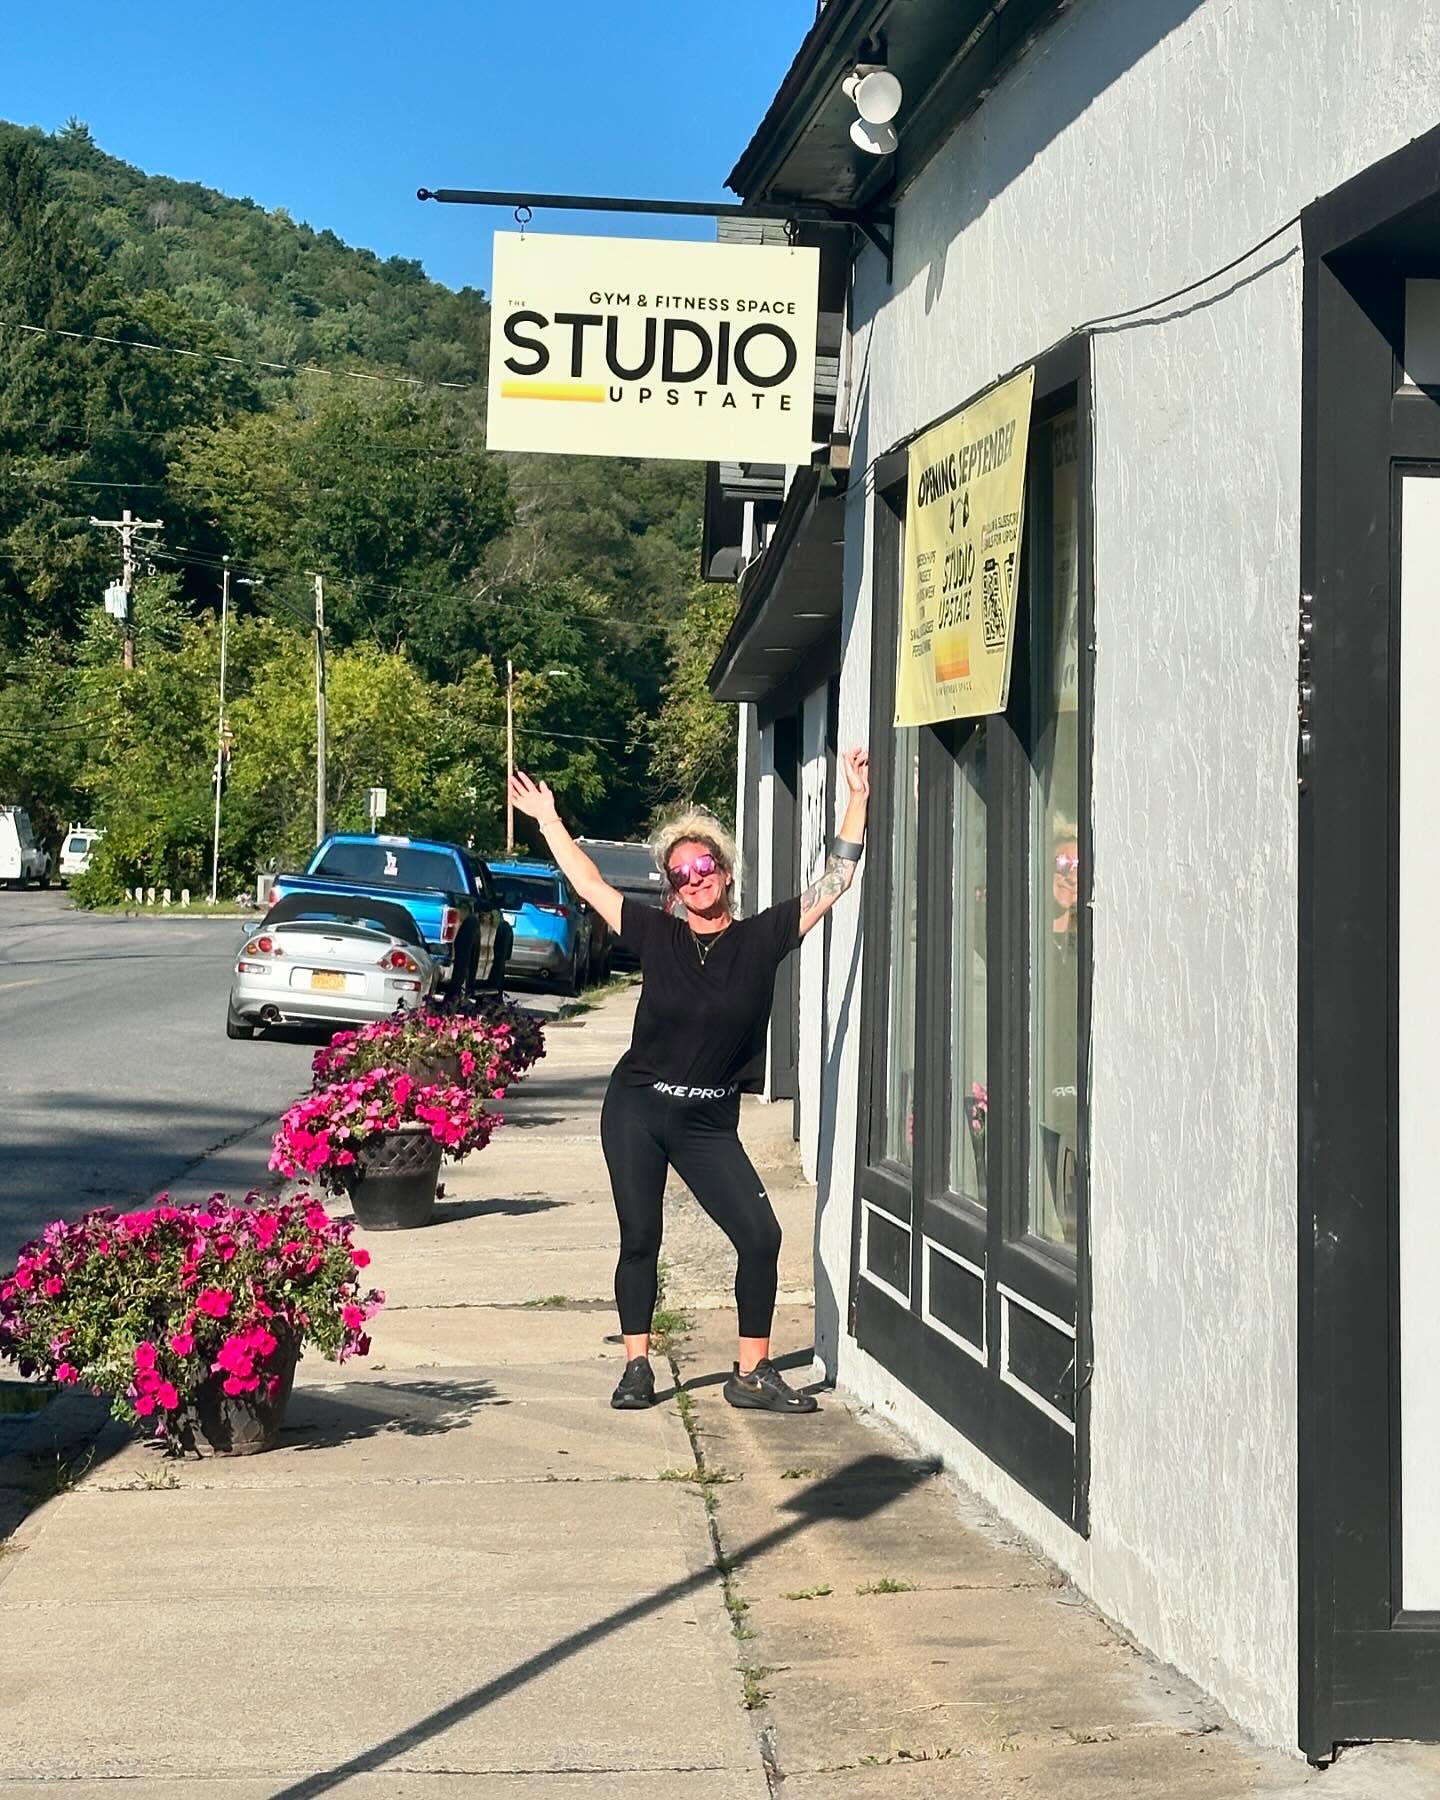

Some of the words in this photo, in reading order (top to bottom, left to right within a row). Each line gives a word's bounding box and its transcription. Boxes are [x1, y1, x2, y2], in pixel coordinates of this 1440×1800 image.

[508, 299, 526, 307] THE
[589, 291, 630, 308] GYM
[636, 294, 648, 308] &
[655, 295, 730, 312] FITNESS
[736, 299, 796, 315] SPACE
[503, 310, 798, 389] STUDIO
[609, 385, 792, 412] UPSTATE
[917, 452, 957, 509] OPENING
[958, 418, 1017, 487] SEPTEMBER
[942, 542, 976, 594] STUDIO
[938, 589, 972, 630] UPSTATE
[688, 1087, 726, 1099] PRO
